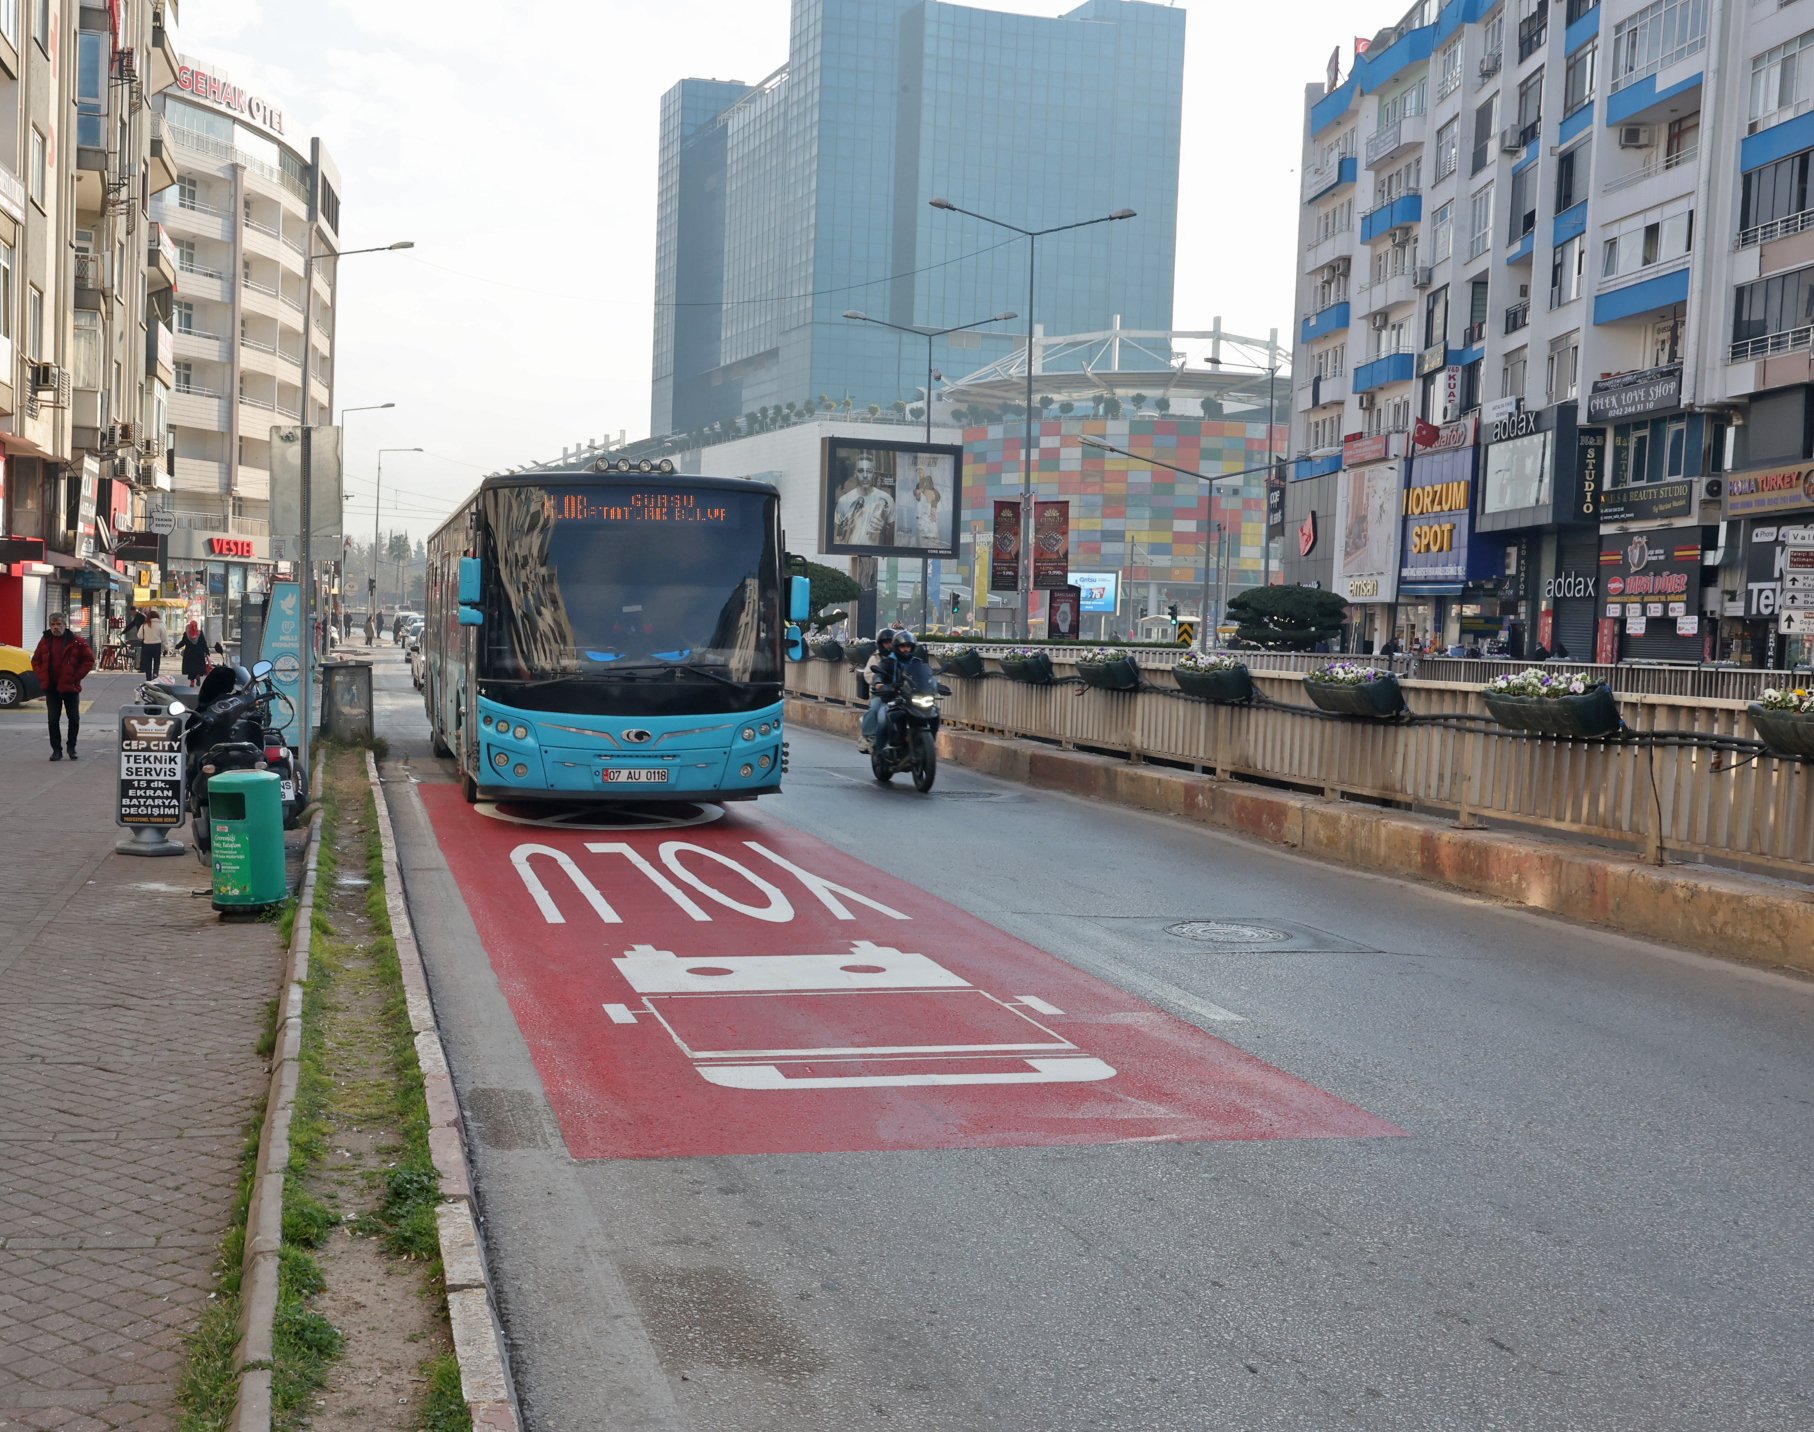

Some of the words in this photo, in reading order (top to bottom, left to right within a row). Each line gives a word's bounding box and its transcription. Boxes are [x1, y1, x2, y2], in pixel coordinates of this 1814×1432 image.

[250, 96, 284, 135] OTEL
[1621, 388, 1646, 405] LOVE
[1649, 380, 1677, 401] SHOP
[1608, 408, 1624, 417] 0242
[1492, 411, 1536, 441] addax
[1583, 448, 1596, 514] STUDIO
[1757, 471, 1798, 494] TURKEY
[1629, 487, 1657, 501] BEAUTY
[1659, 484, 1688, 498] STUDIO
[1412, 523, 1457, 554] SPOT
[1759, 530, 1775, 538] iPhone
[210, 537, 256, 556] VESTEL
[1349, 579, 1378, 597] emsan
[1545, 570, 1596, 598] addax
[1654, 570, 1688, 594] DÖNER
[122, 740, 147, 750] CEP
[150, 740, 181, 751] CITY
[151, 780, 170, 788] dk.
[608, 770, 621, 781] 07
[627, 770, 641, 781] AU
[646, 770, 667, 781] 0118
[128, 789, 173, 797] EKRAN
[121, 807, 179, 816] DEĞİŞİMİ
[510, 841, 913, 924] YOLU
